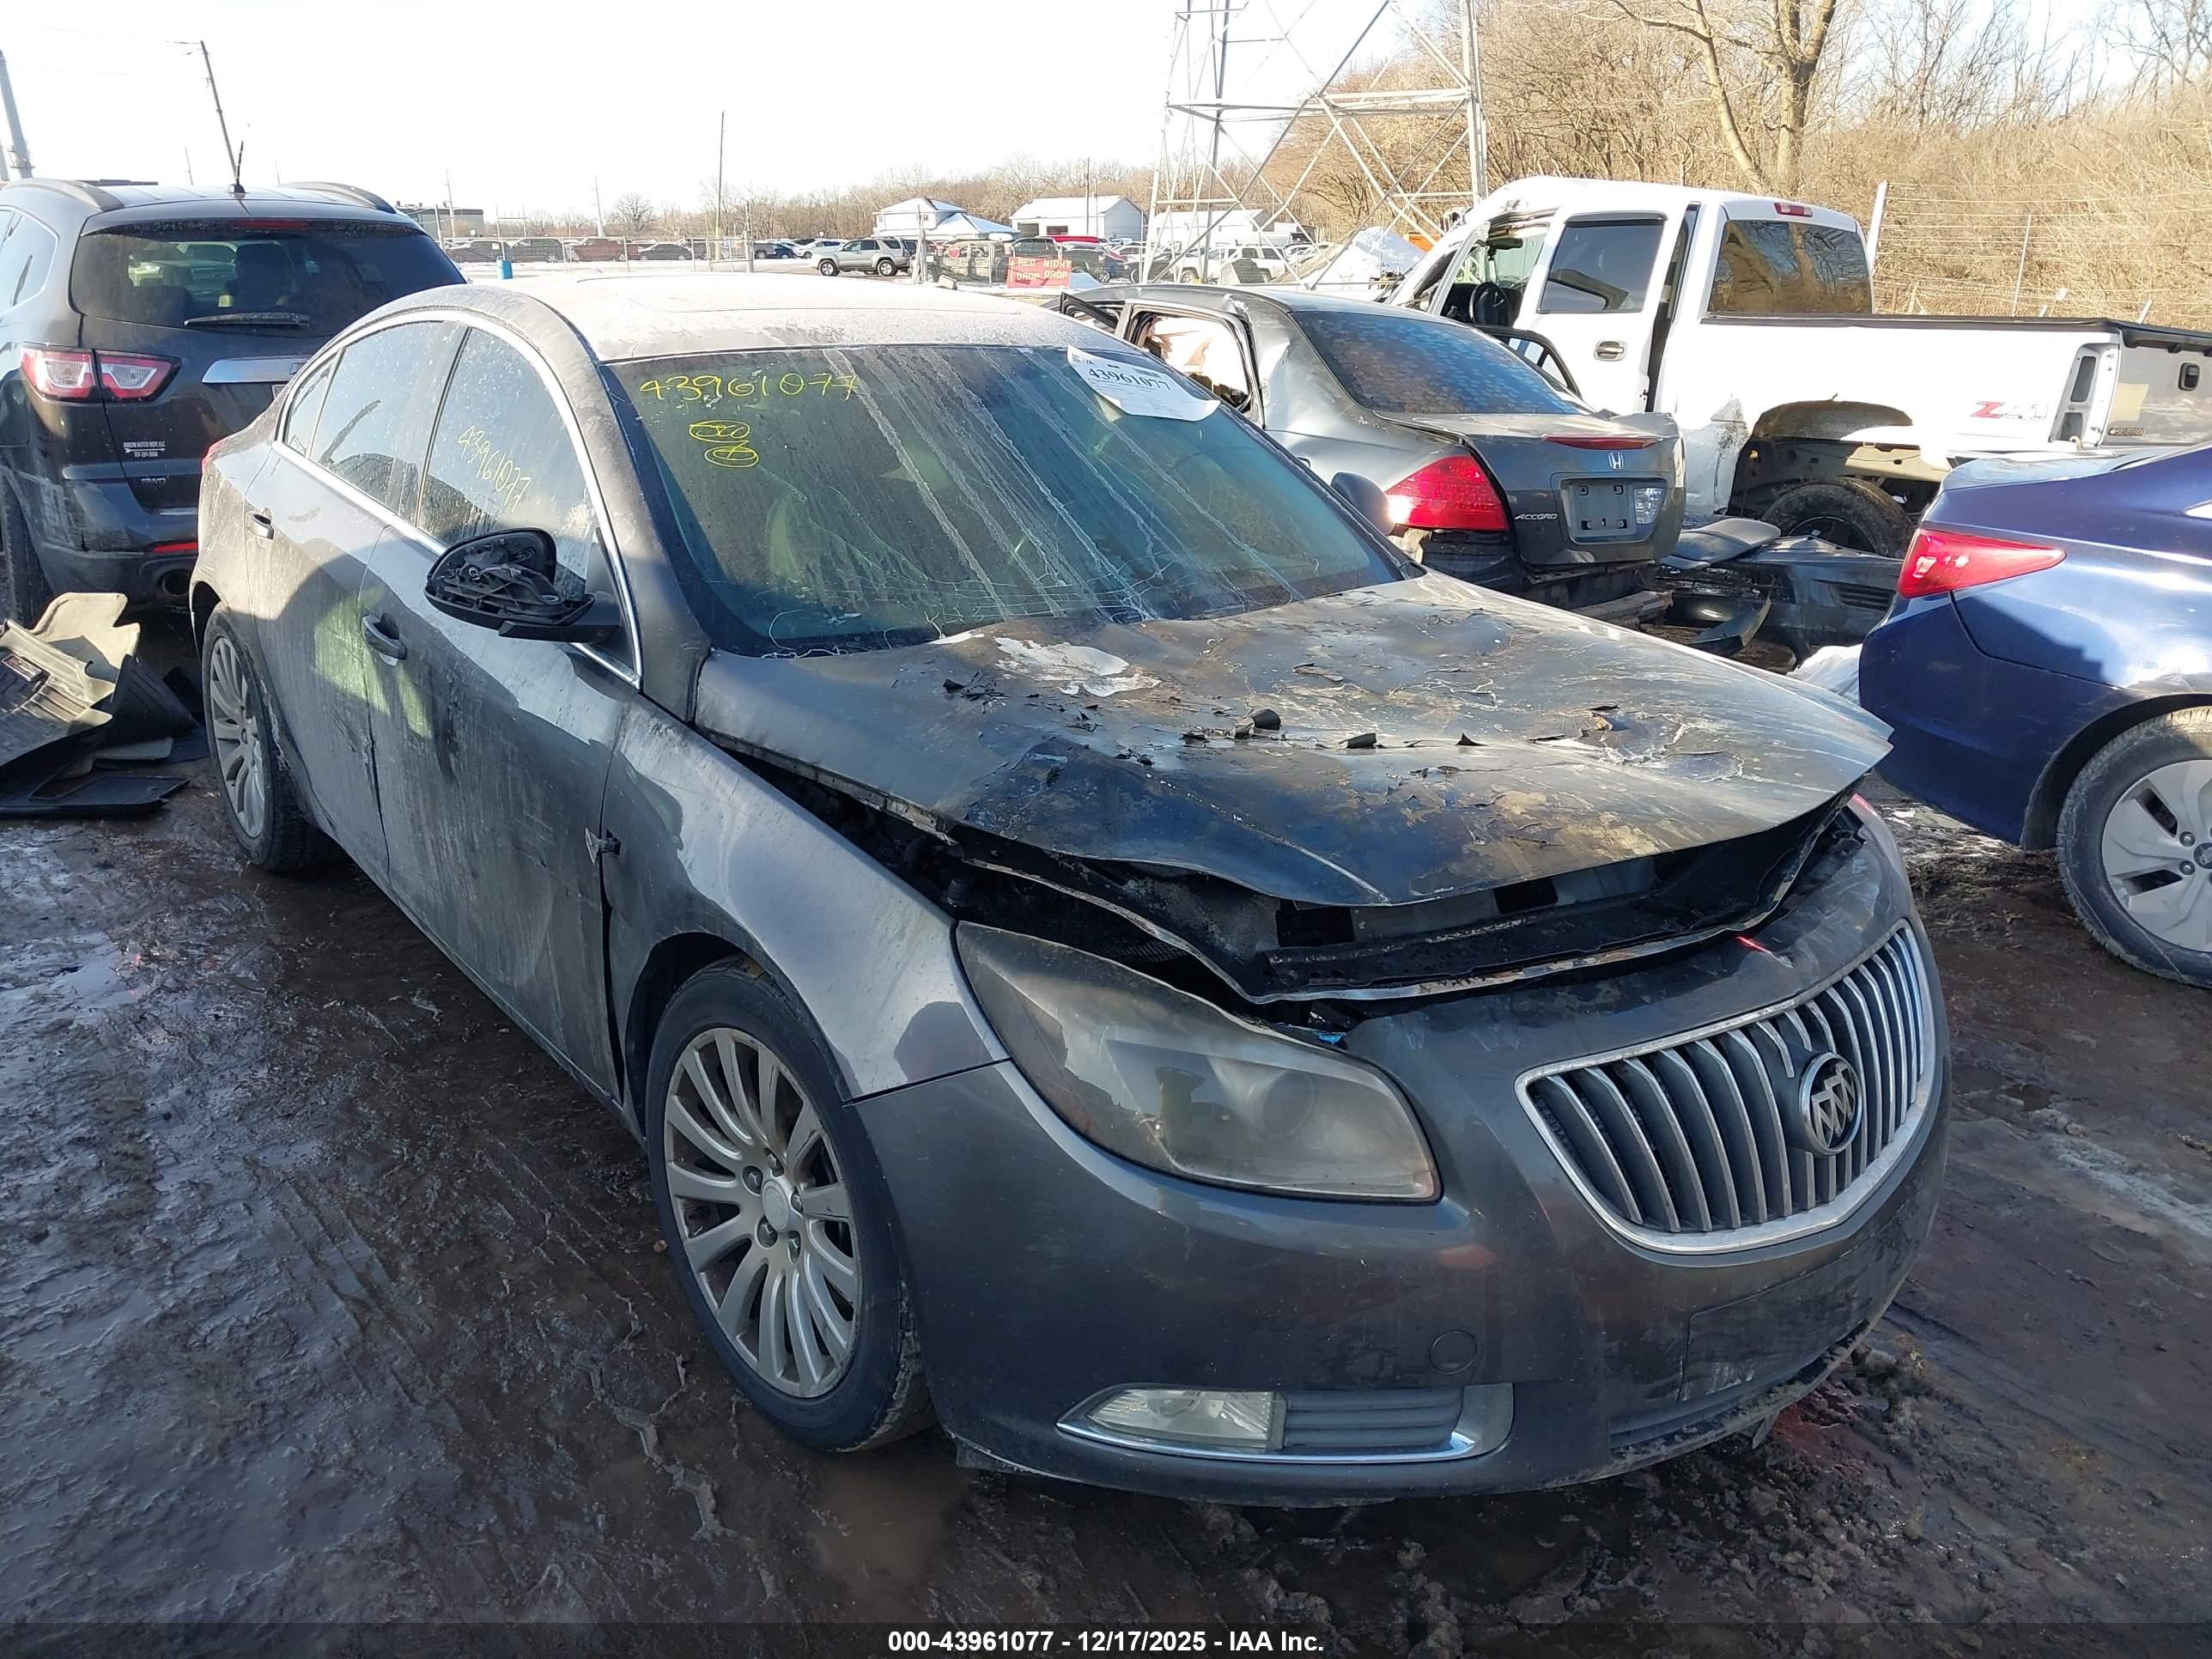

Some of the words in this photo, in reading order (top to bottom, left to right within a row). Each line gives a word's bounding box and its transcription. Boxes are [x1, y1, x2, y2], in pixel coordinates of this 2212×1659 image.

[1043, 259, 1072, 268] NIGHT
[1016, 272, 1040, 281] DROP
[1044, 270, 1067, 279] DROP
[639, 373, 860, 402] 43961077
[1090, 368, 1171, 392] 43961077
[458, 426, 531, 514] 43961077
